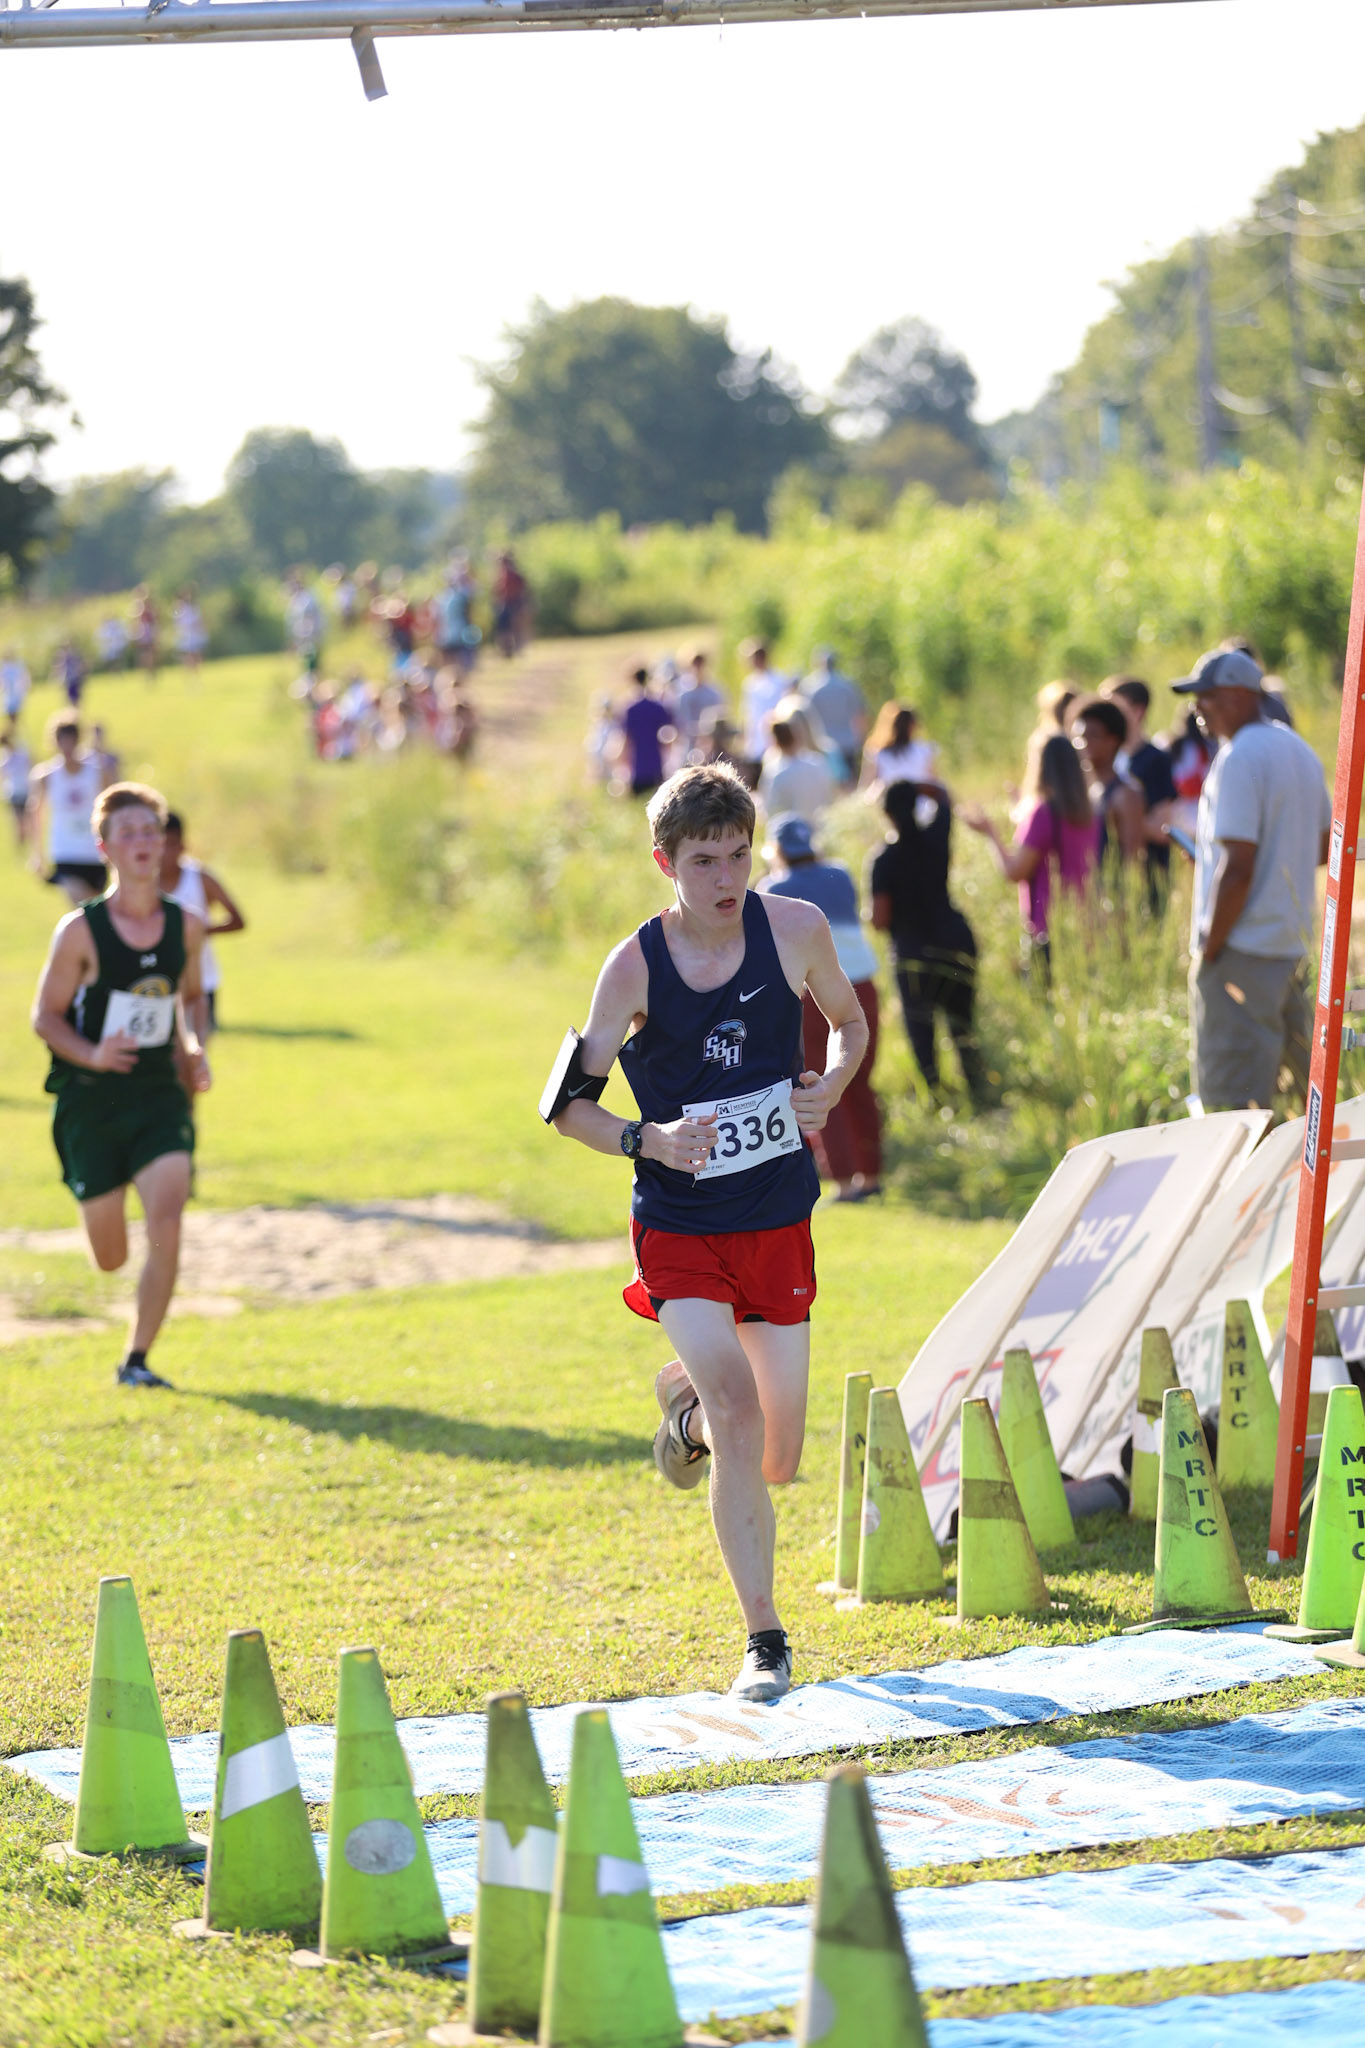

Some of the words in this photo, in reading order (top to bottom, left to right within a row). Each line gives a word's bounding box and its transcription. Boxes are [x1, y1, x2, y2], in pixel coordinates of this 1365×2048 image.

[705, 1035, 740, 1066] SBA
[718, 1105, 730, 1115] M
[1177, 1429, 1218, 1537] MRTC
